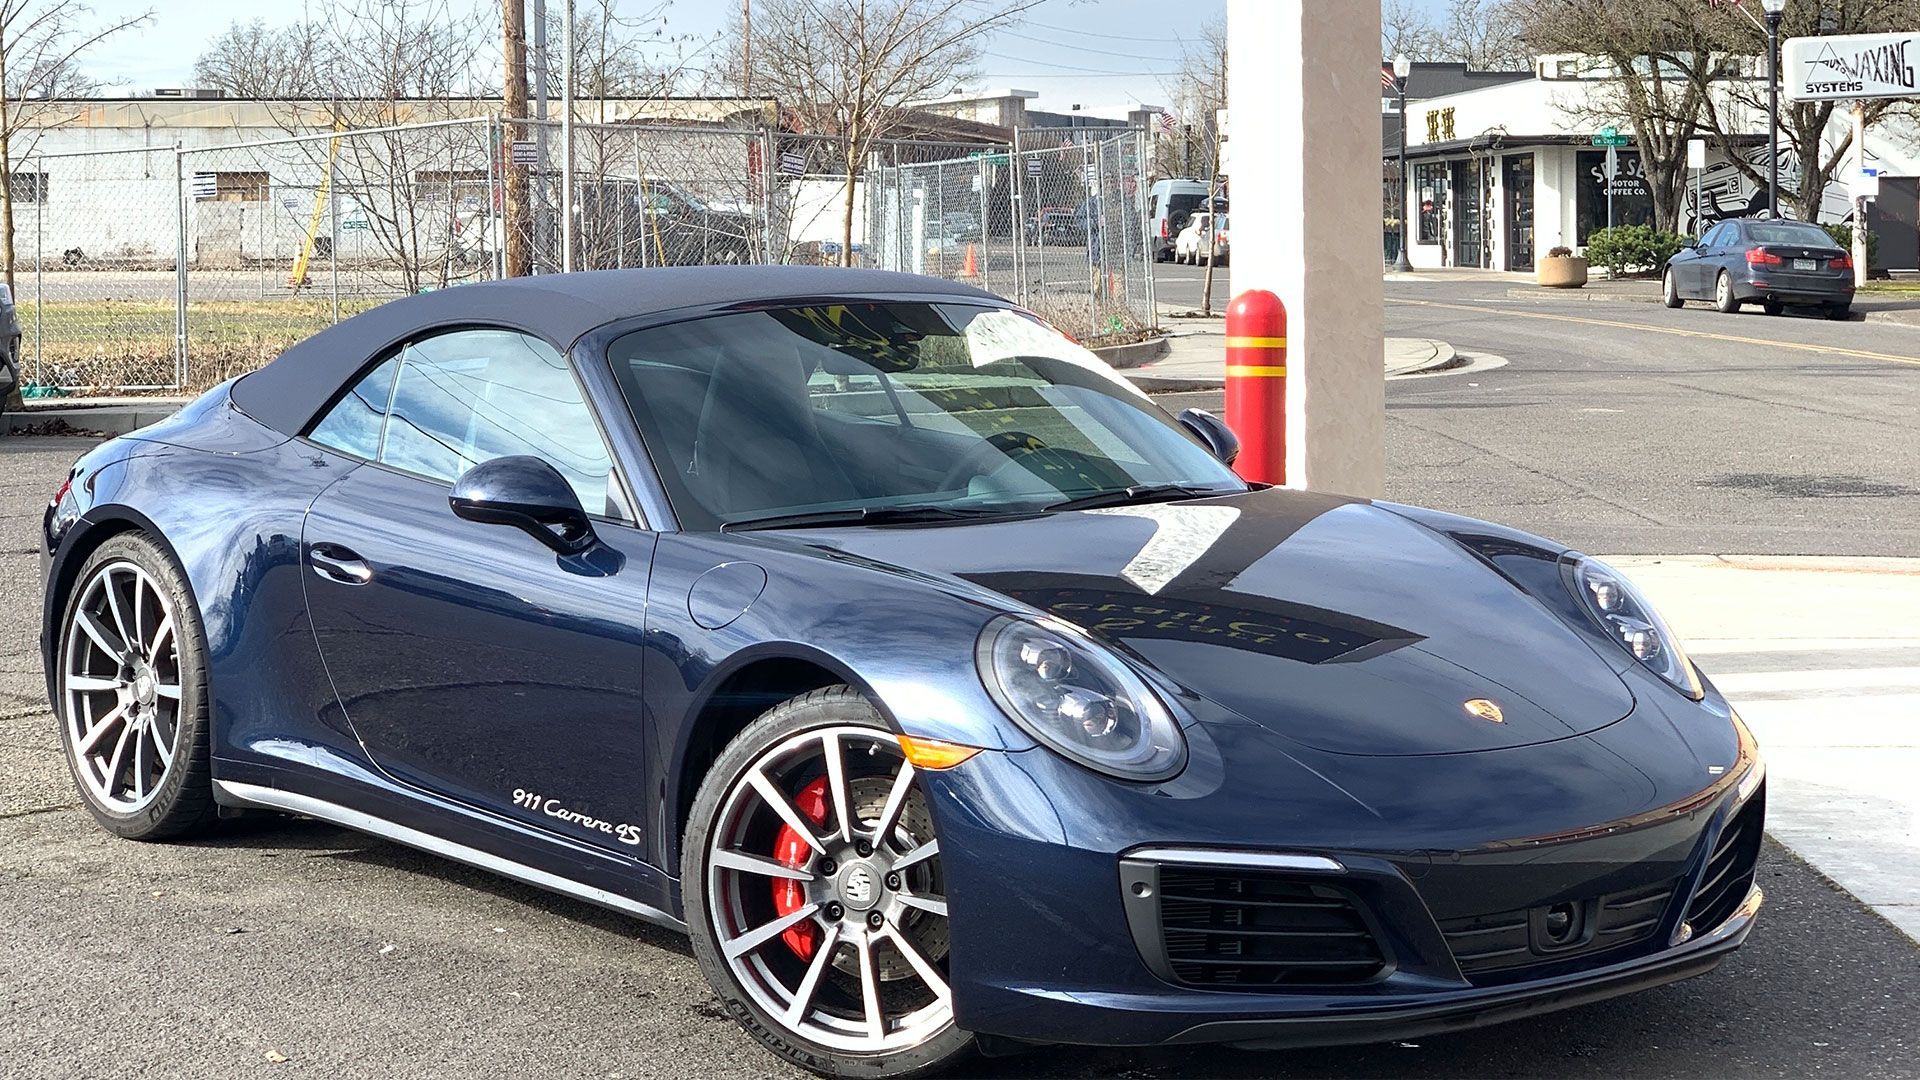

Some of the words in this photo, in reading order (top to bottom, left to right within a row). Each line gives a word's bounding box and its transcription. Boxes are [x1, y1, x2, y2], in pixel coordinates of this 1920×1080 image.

[1805, 81, 1864, 93] SYSTEMS
[1840, 39, 1915, 89] WAXING
[1603, 188, 1633, 196] COFFEE
[1634, 188, 1648, 196] CO.
[512, 788, 542, 810] 911
[543, 799, 613, 834] Carrera
[615, 823, 641, 845] 4S
[732, 1000, 810, 1063] MICHELIN
